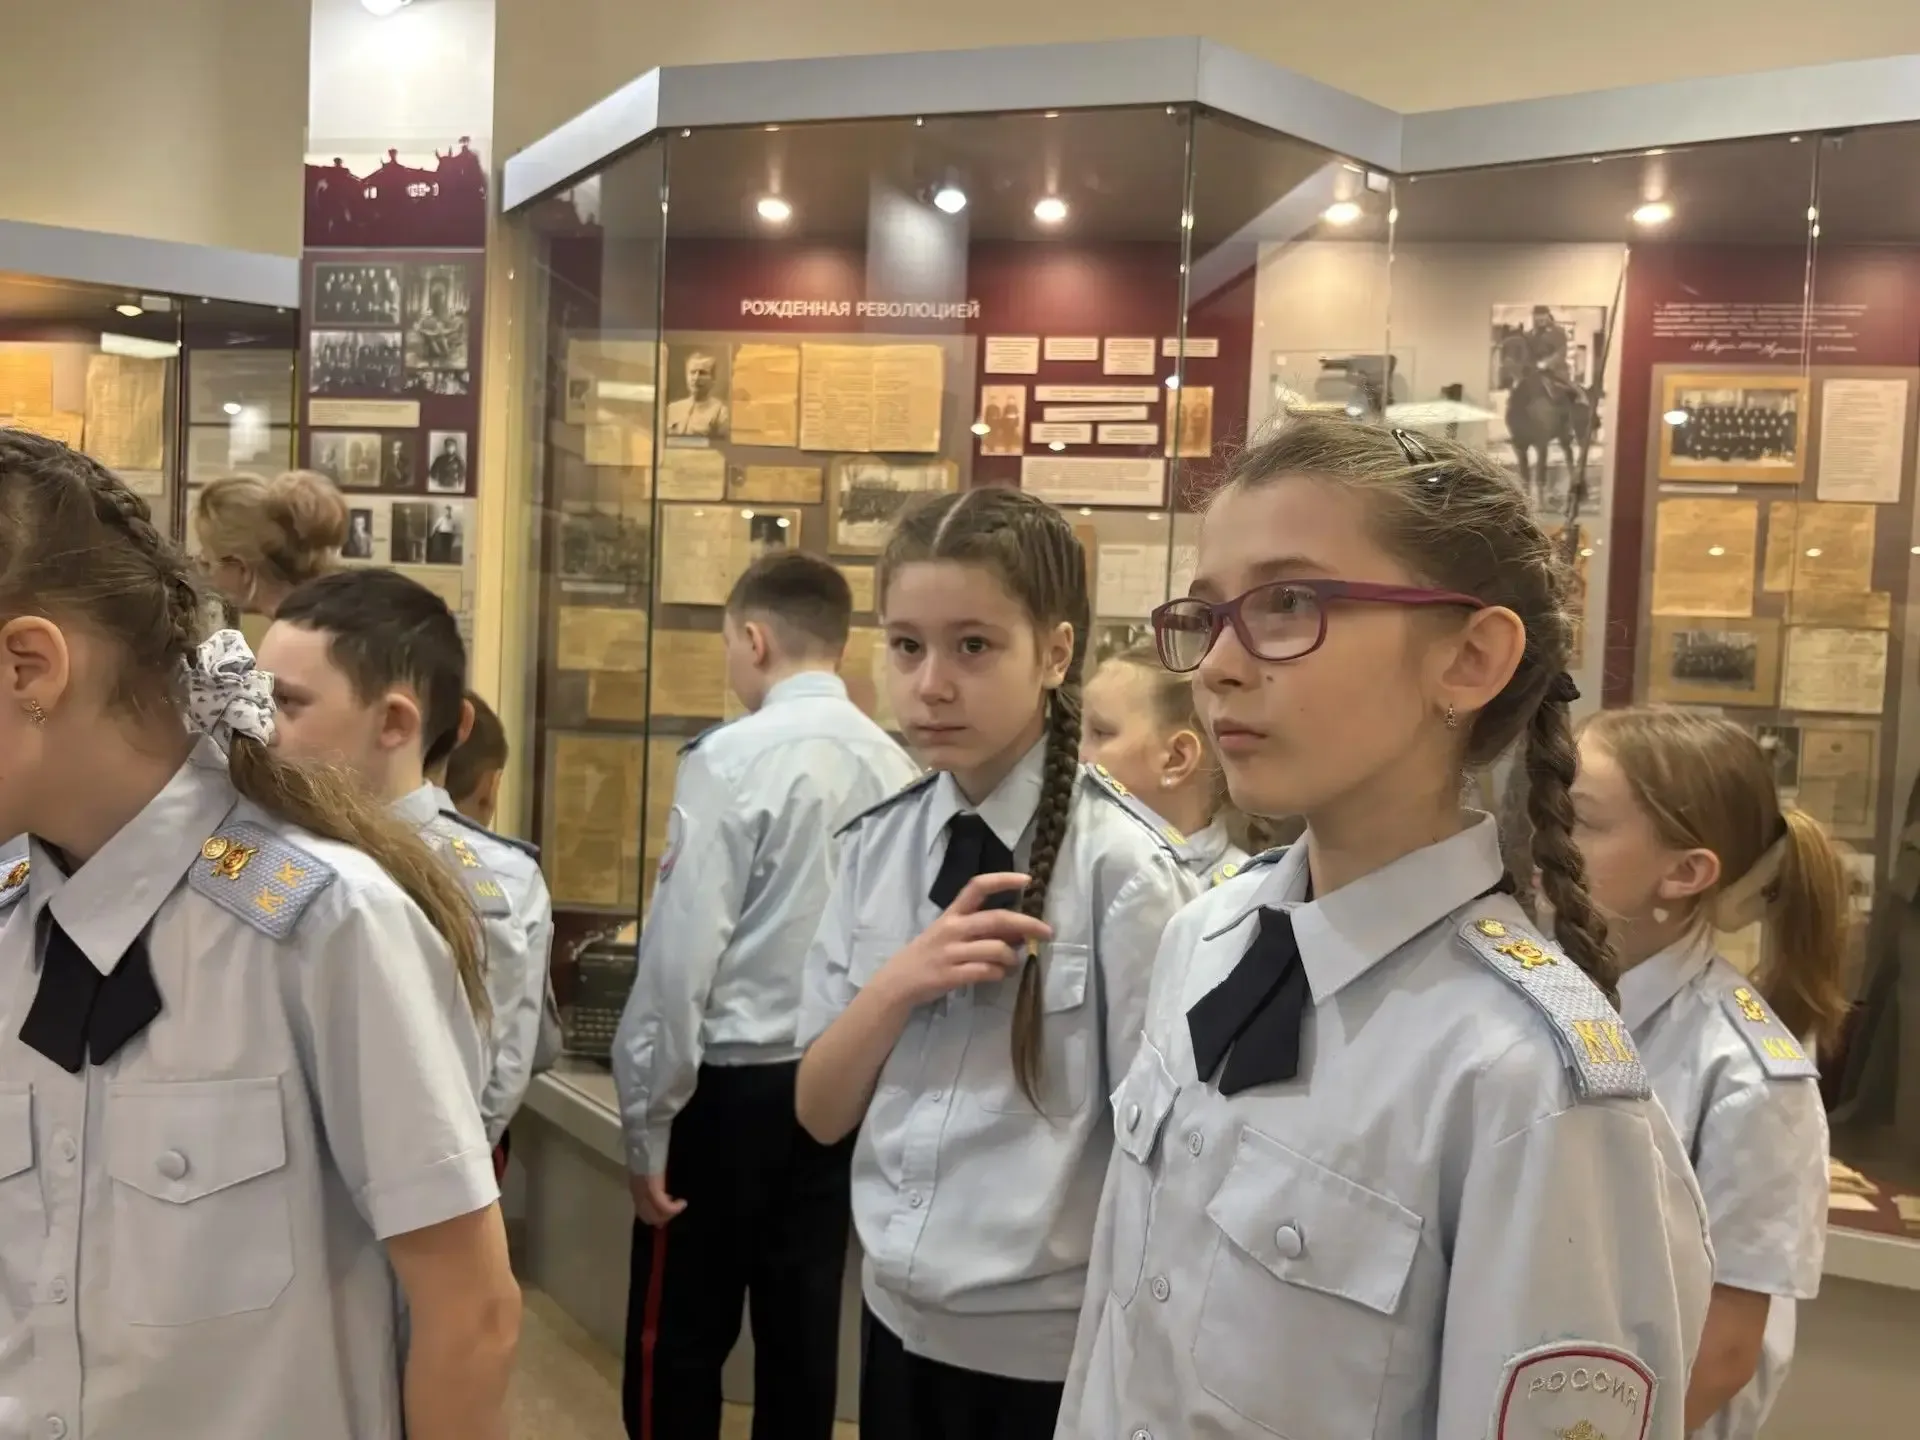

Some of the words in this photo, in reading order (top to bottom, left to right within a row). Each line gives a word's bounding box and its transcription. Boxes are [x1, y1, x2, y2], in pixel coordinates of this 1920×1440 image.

[740, 300, 850, 318] РОЖДЕННАЯ
[856, 300, 980, 319] РЕВОЛЮЦИЕЙ
[1528, 1368, 1639, 1414] РОССИЯ
